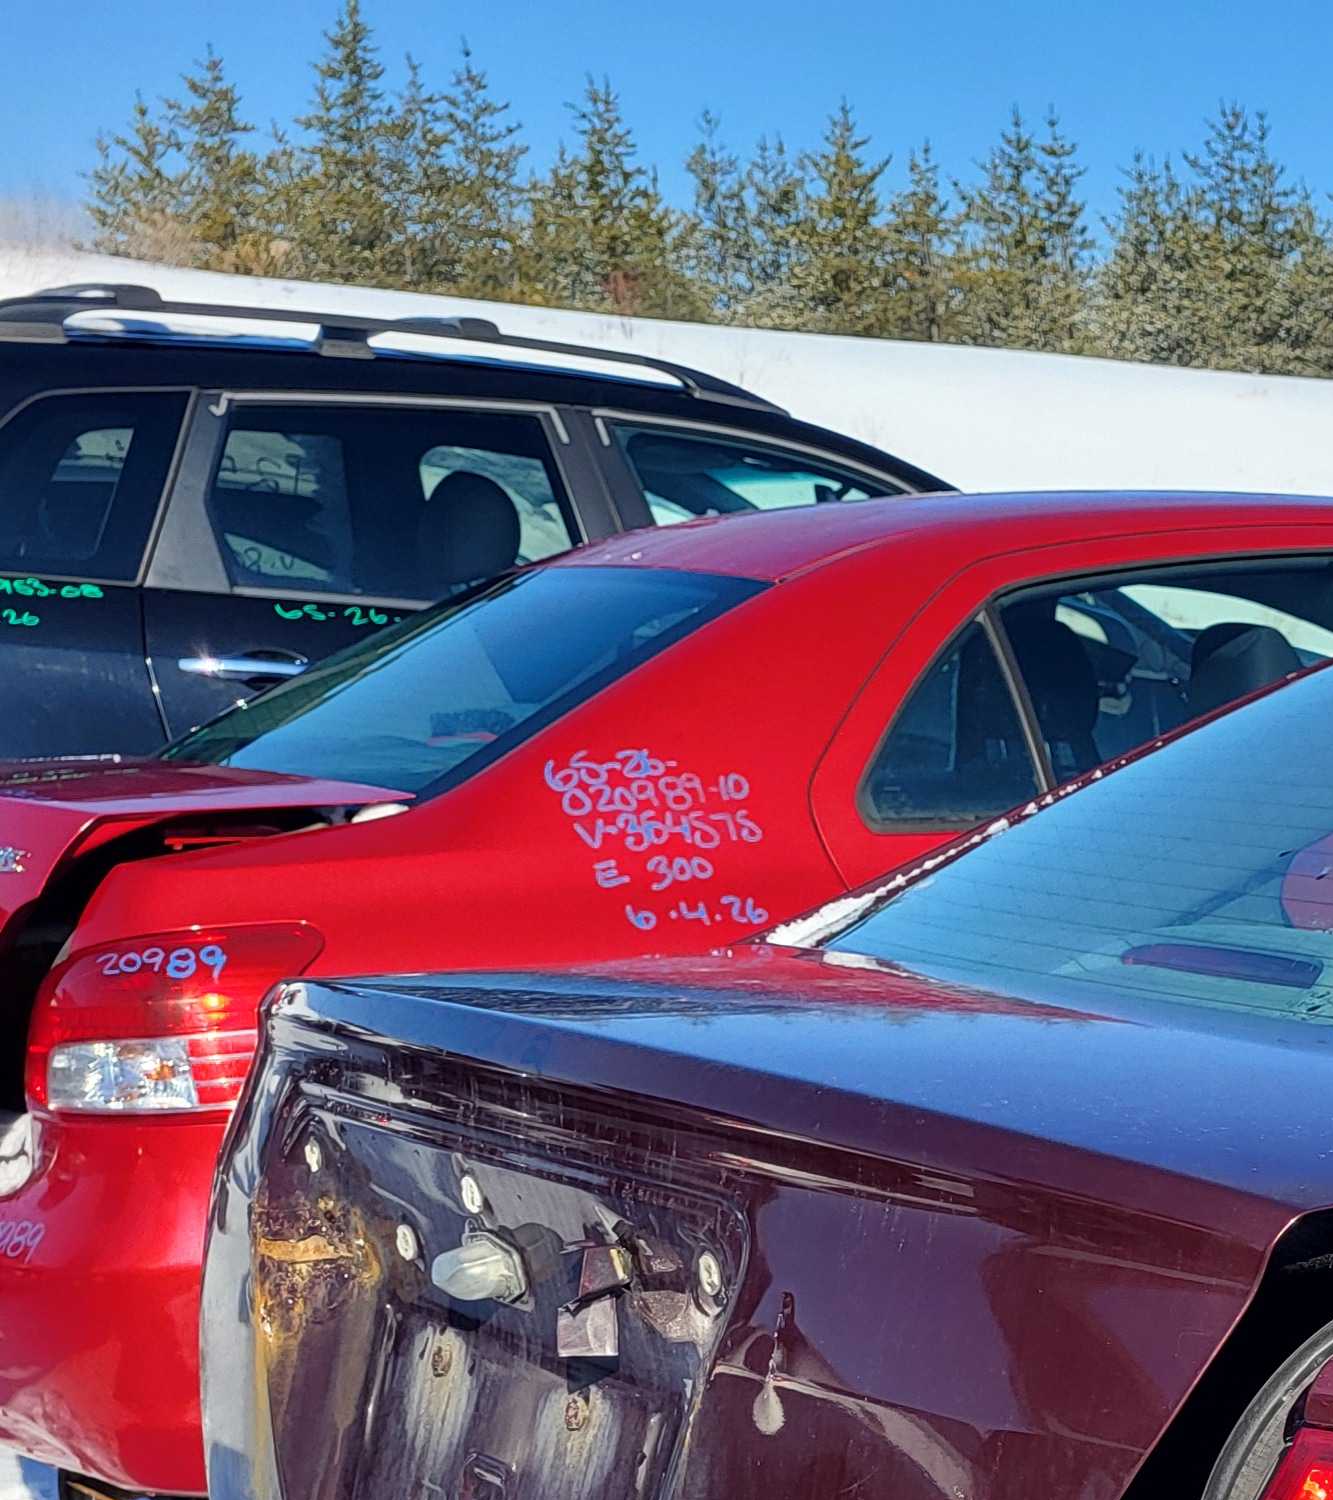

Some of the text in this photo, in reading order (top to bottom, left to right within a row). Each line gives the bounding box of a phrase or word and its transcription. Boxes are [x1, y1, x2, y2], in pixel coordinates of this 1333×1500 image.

[593, 855, 714, 891] E 300
[95, 944, 227, 984] 20989
